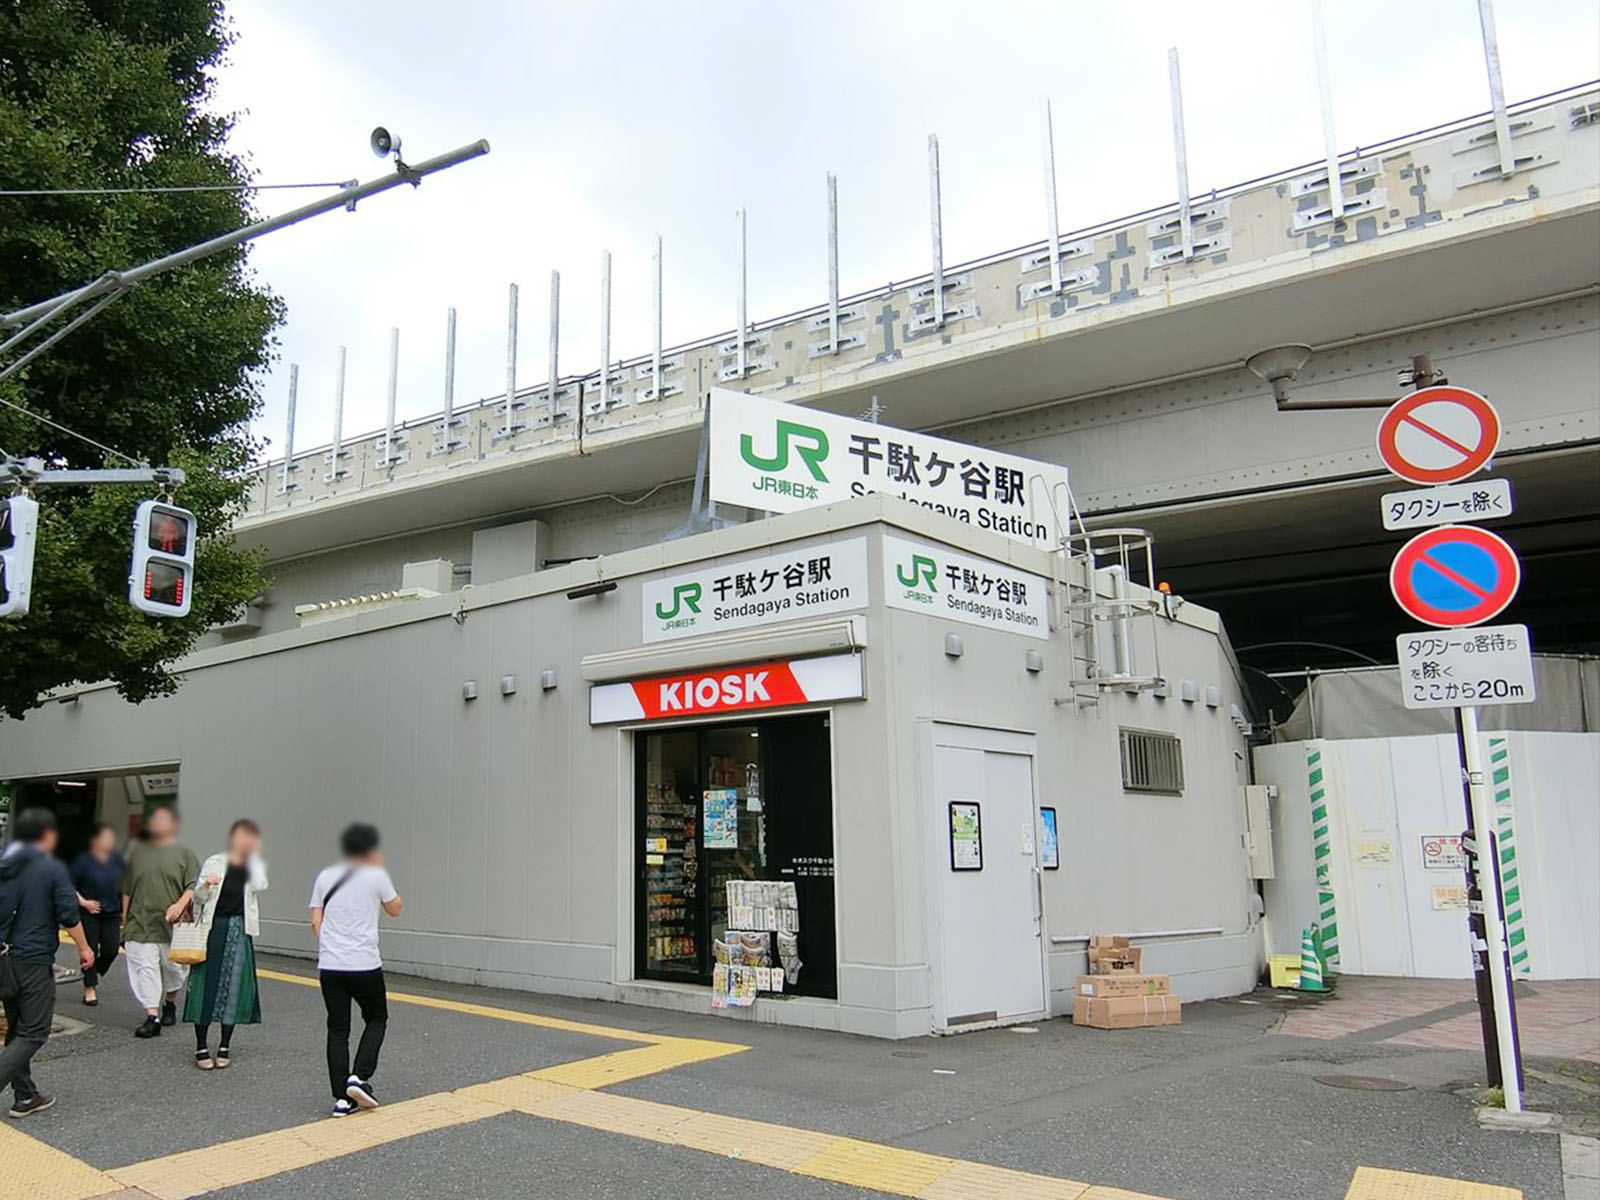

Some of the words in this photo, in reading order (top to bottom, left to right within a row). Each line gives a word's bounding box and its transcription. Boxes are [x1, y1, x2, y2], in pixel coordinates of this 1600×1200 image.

[740, 419, 830, 483] JR
[848, 433, 1026, 507] 千駄ケ谷駅
[752, 478, 819, 500] JR東日本
[1390, 490, 1503, 522] タクシーを除く
[978, 507, 1047, 540] Station
[712, 555, 832, 602] 千駄ケ谷駅
[896, 554, 938, 593] JR
[945, 564, 1028, 607] 千駄ケ谷駅
[655, 582, 702, 620] JR
[713, 599, 791, 622] Sendagaya
[795, 585, 850, 607] Station
[947, 593, 1003, 621] Sendagaya
[1005, 607, 1039, 627] Station
[662, 617, 697, 631] JR東日本
[1407, 633, 1518, 658] タクシーの客待ち
[1410, 661, 1453, 679] を除く
[659, 671, 773, 712] KIOSK
[1413, 678, 1524, 701] ここから20m
